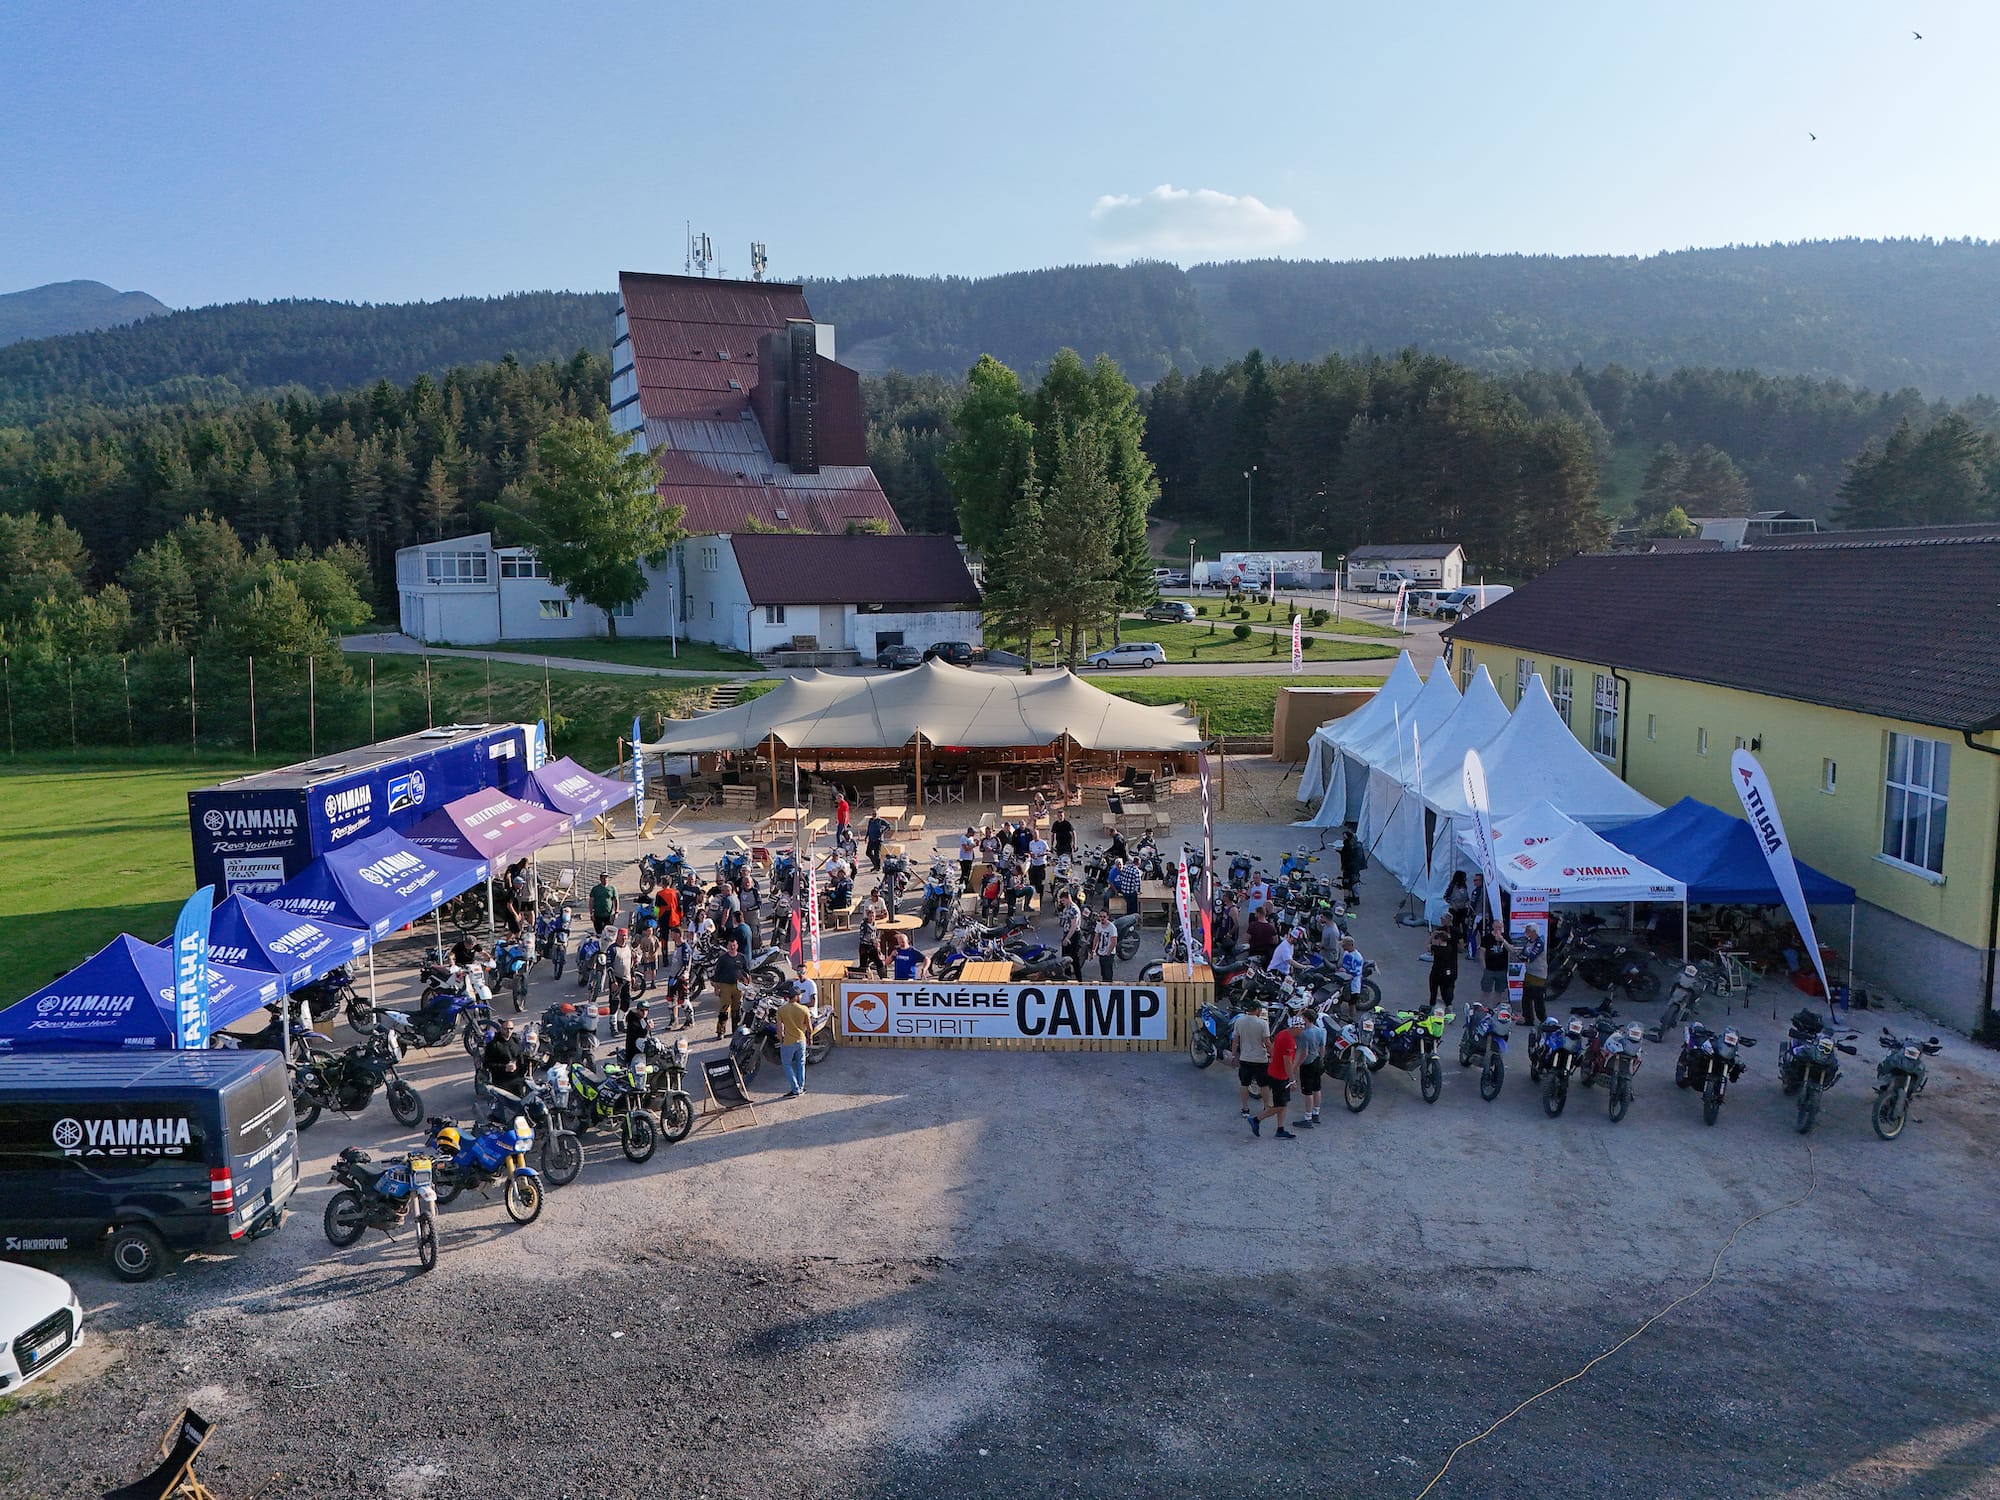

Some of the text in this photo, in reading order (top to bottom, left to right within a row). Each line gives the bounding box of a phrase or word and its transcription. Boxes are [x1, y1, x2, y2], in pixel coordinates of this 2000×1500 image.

[633, 739, 644, 802] YAMAHA
[335, 784, 372, 813] YAMAHA
[224, 808, 298, 829] YAMAHA
[330, 805, 370, 824] RACING
[212, 828, 294, 837] RACING
[212, 841, 246, 854] Revs
[369, 850, 422, 878] YAMAHA
[1576, 866, 1630, 876] YAMAHA
[382, 864, 426, 888] RACING
[231, 882, 281, 893] GYTR
[283, 898, 336, 911] YAMAHA
[207, 945, 248, 960] MAHA
[60, 995, 134, 1012] YAMAHA
[896, 987, 1009, 1008] TÉNÉRÉ
[1016, 987, 1160, 1037] CAMP
[896, 1018, 980, 1035] SPIRIT
[85, 1117, 192, 1146] YAMAHA
[64, 1147, 184, 1156] RACING
